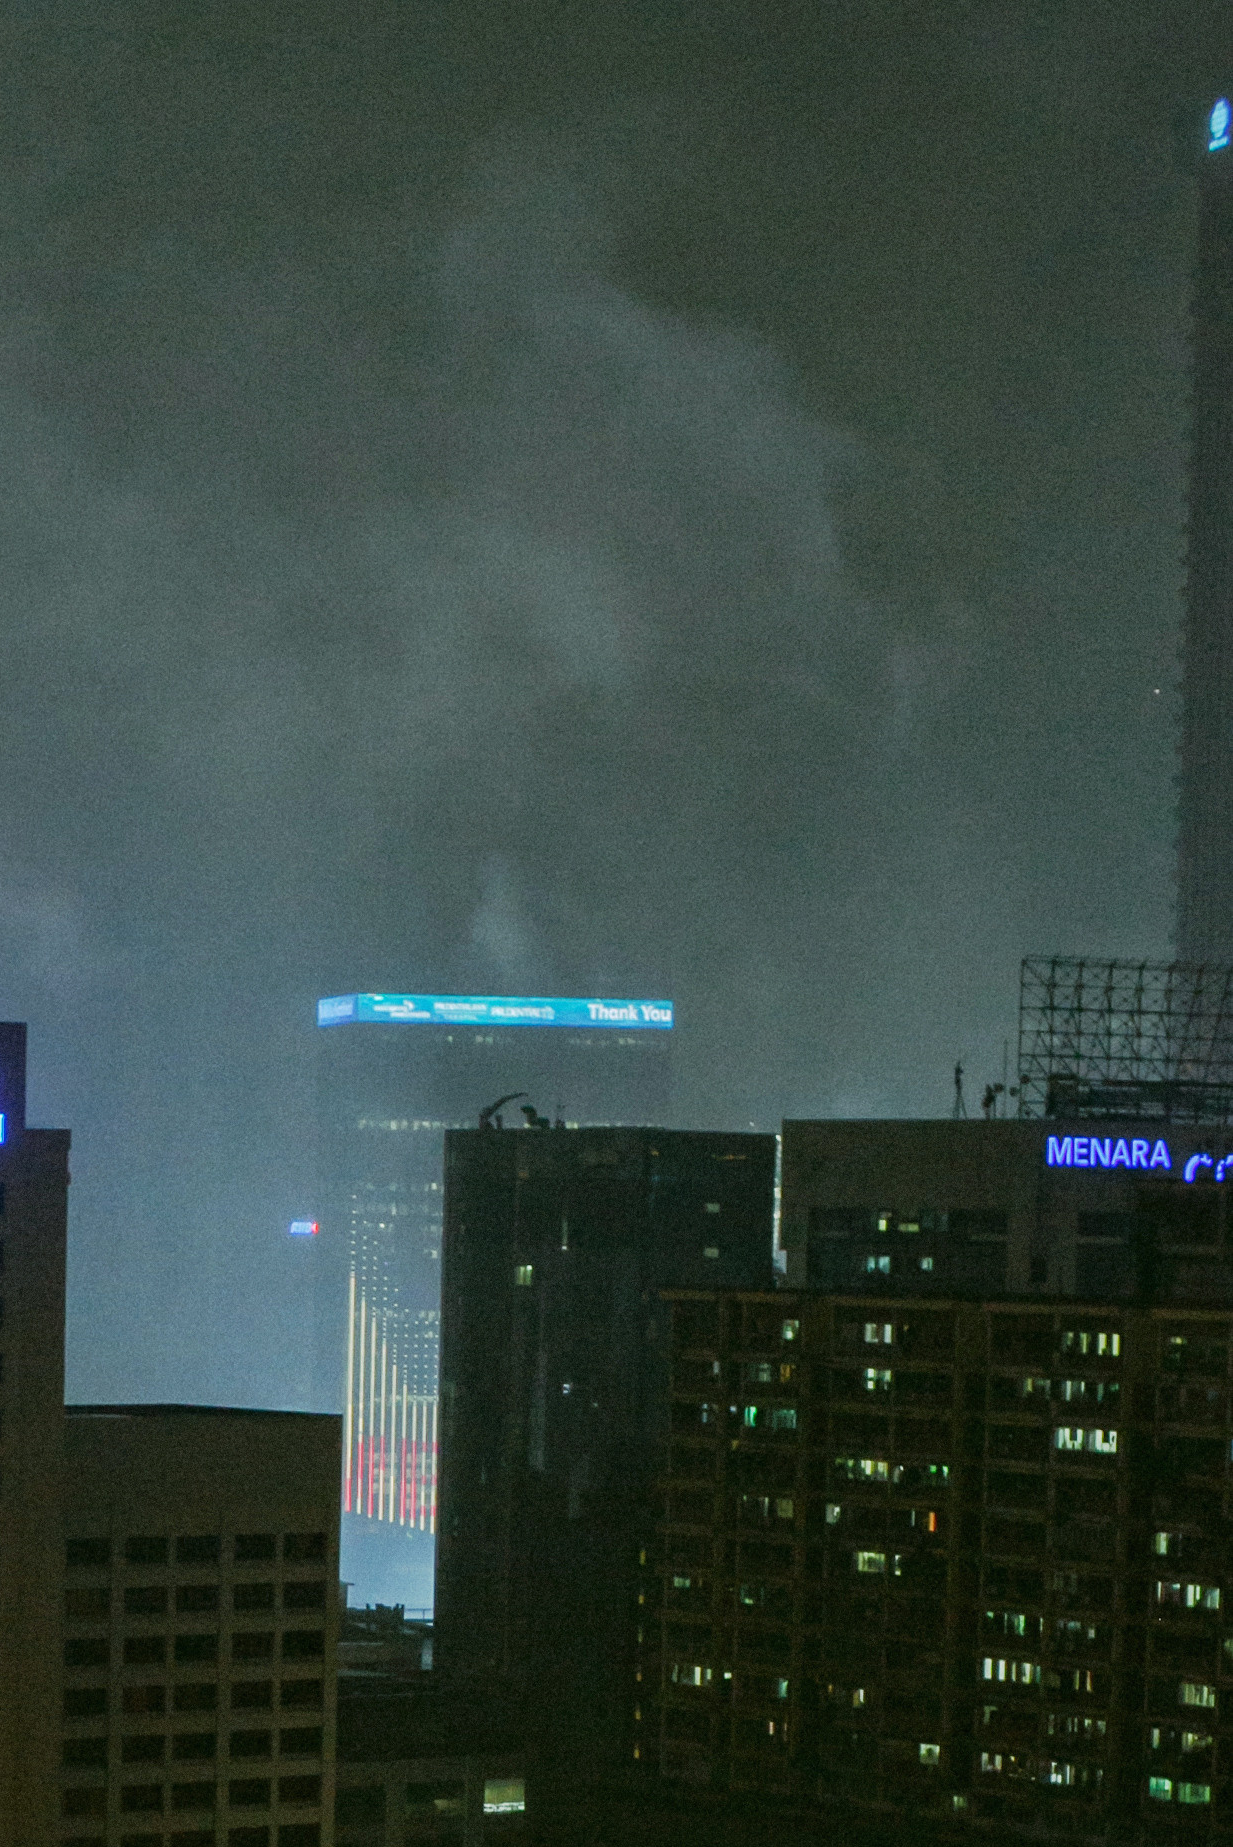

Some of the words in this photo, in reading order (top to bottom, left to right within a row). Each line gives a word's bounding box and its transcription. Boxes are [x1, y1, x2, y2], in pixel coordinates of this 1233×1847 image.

[587, 1003, 638, 1021] Thank
[641, 1004, 672, 1022] You
[1047, 1135, 1172, 1170] MENARA
